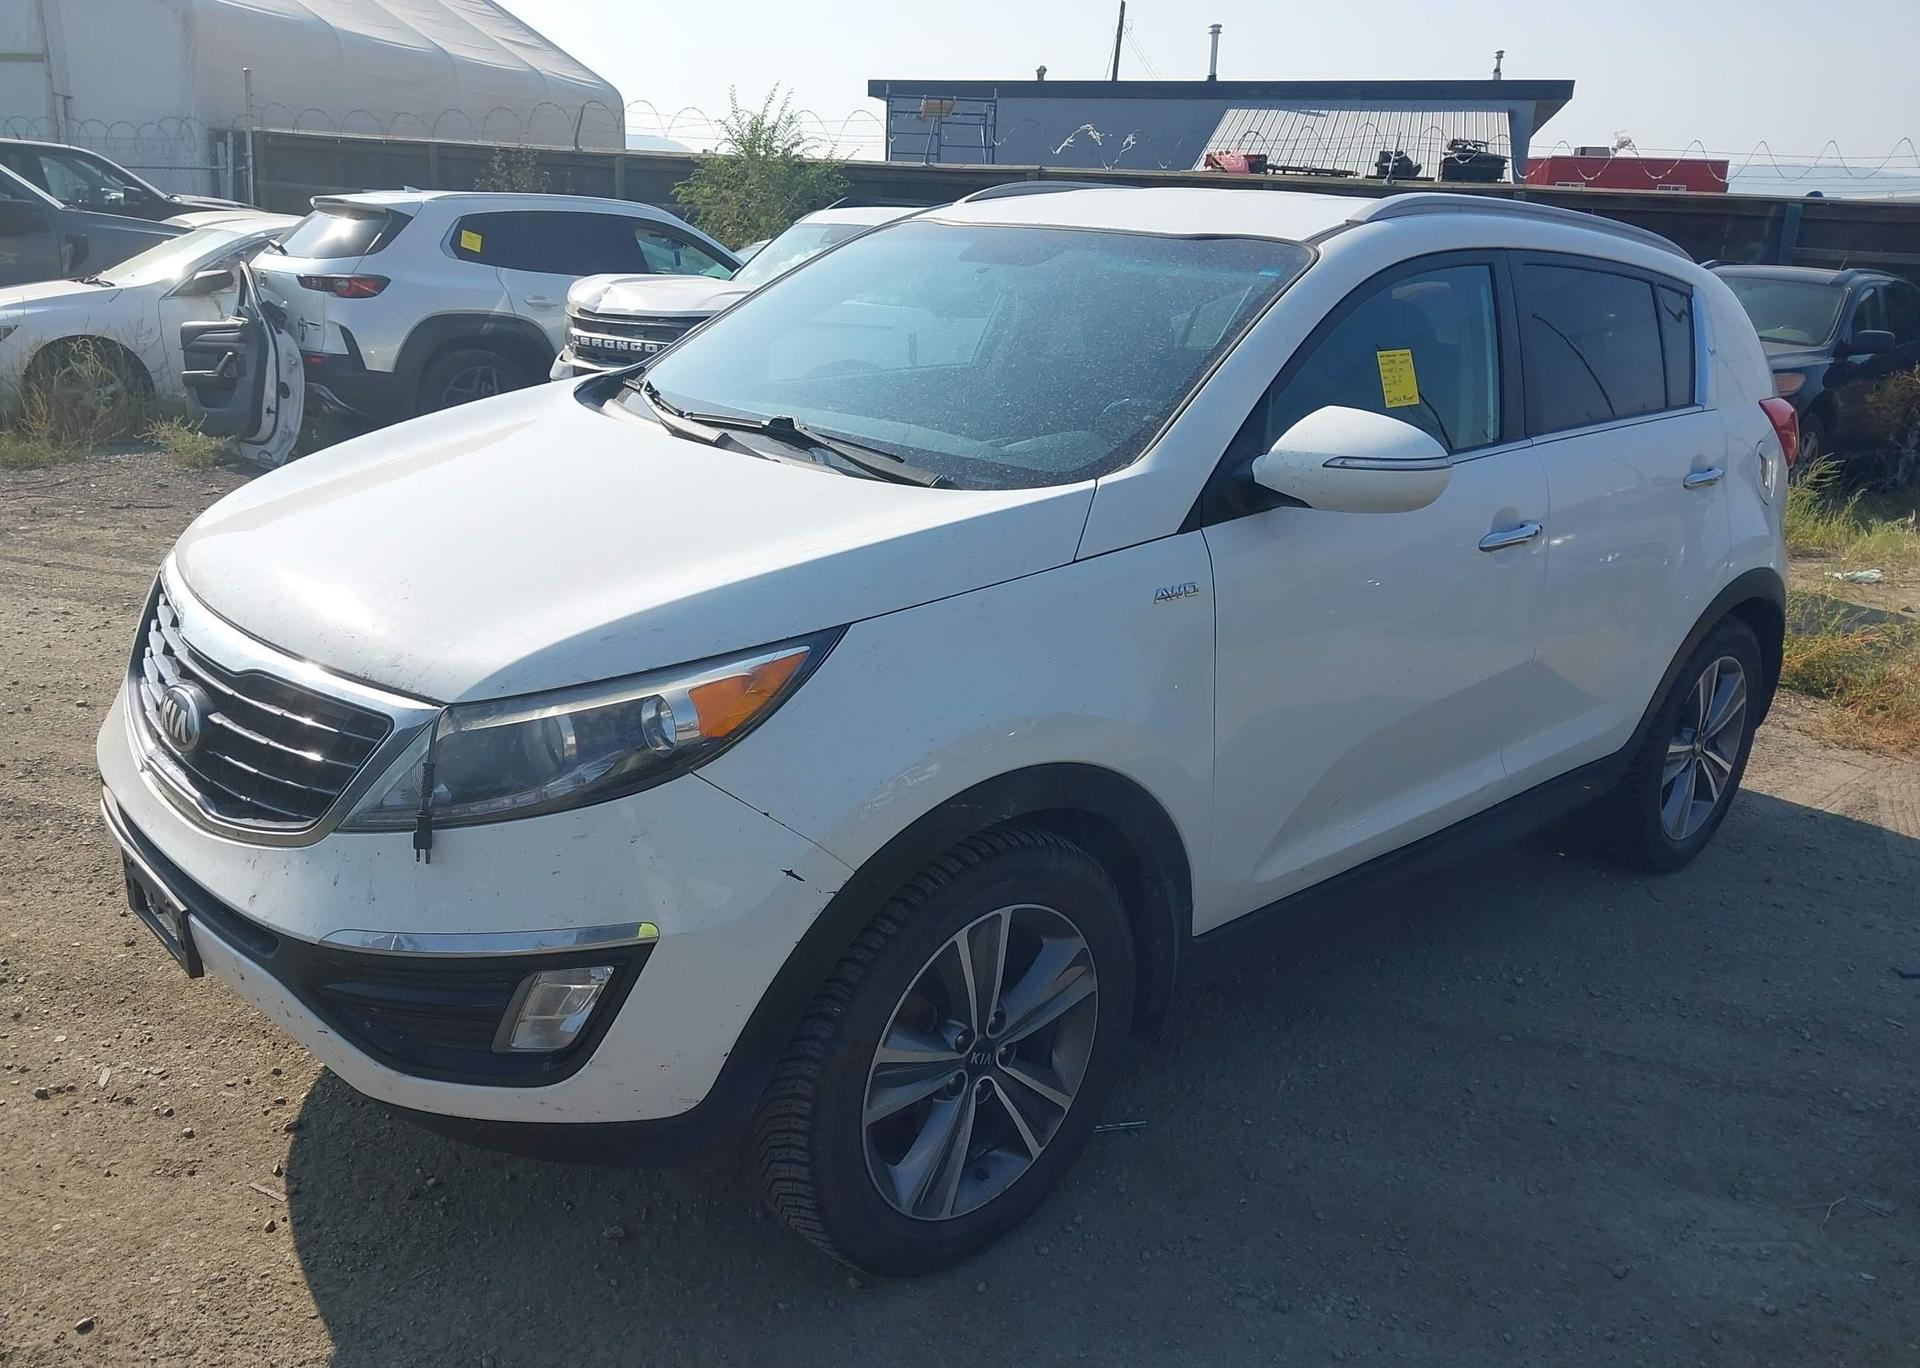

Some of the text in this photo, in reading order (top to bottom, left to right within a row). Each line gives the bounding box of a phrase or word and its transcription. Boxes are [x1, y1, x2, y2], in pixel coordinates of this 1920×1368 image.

[580, 337, 658, 353] BRONCO
[1153, 581, 1199, 604] AWD
[970, 1051, 992, 1065] KIA
